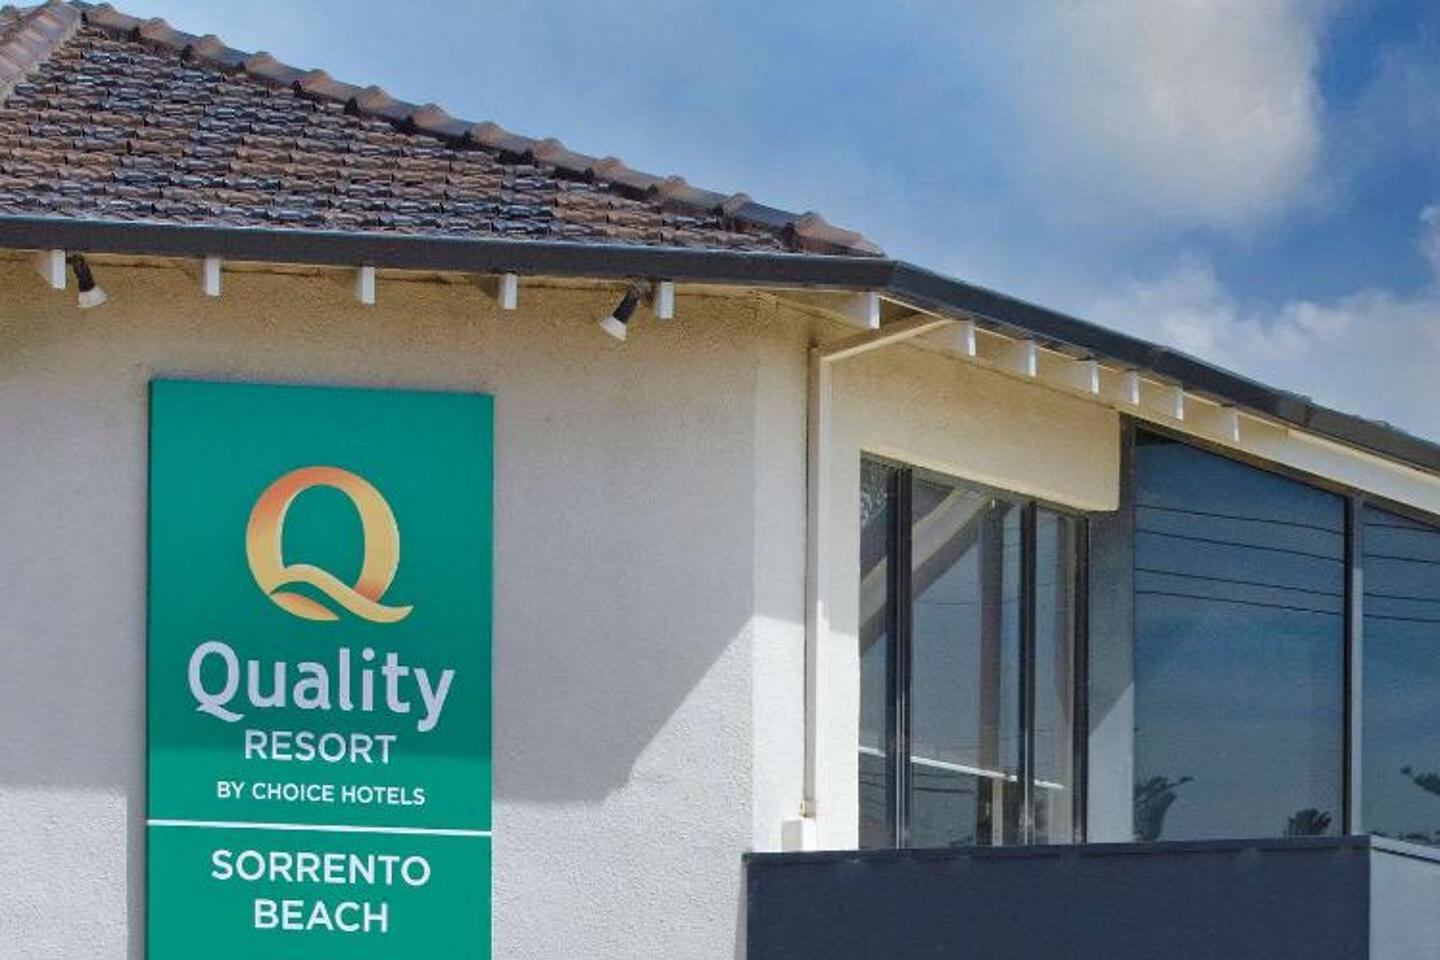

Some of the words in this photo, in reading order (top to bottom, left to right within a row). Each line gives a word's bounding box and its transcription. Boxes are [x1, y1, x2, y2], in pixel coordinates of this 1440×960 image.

[189, 641, 454, 732] Quality
[245, 730, 396, 763] RESORT
[217, 781, 244, 798] BY
[252, 783, 334, 801] CHOICE
[342, 786, 425, 805] HOTELS
[212, 849, 430, 886] SORRENTO
[255, 899, 387, 932] BEACH
